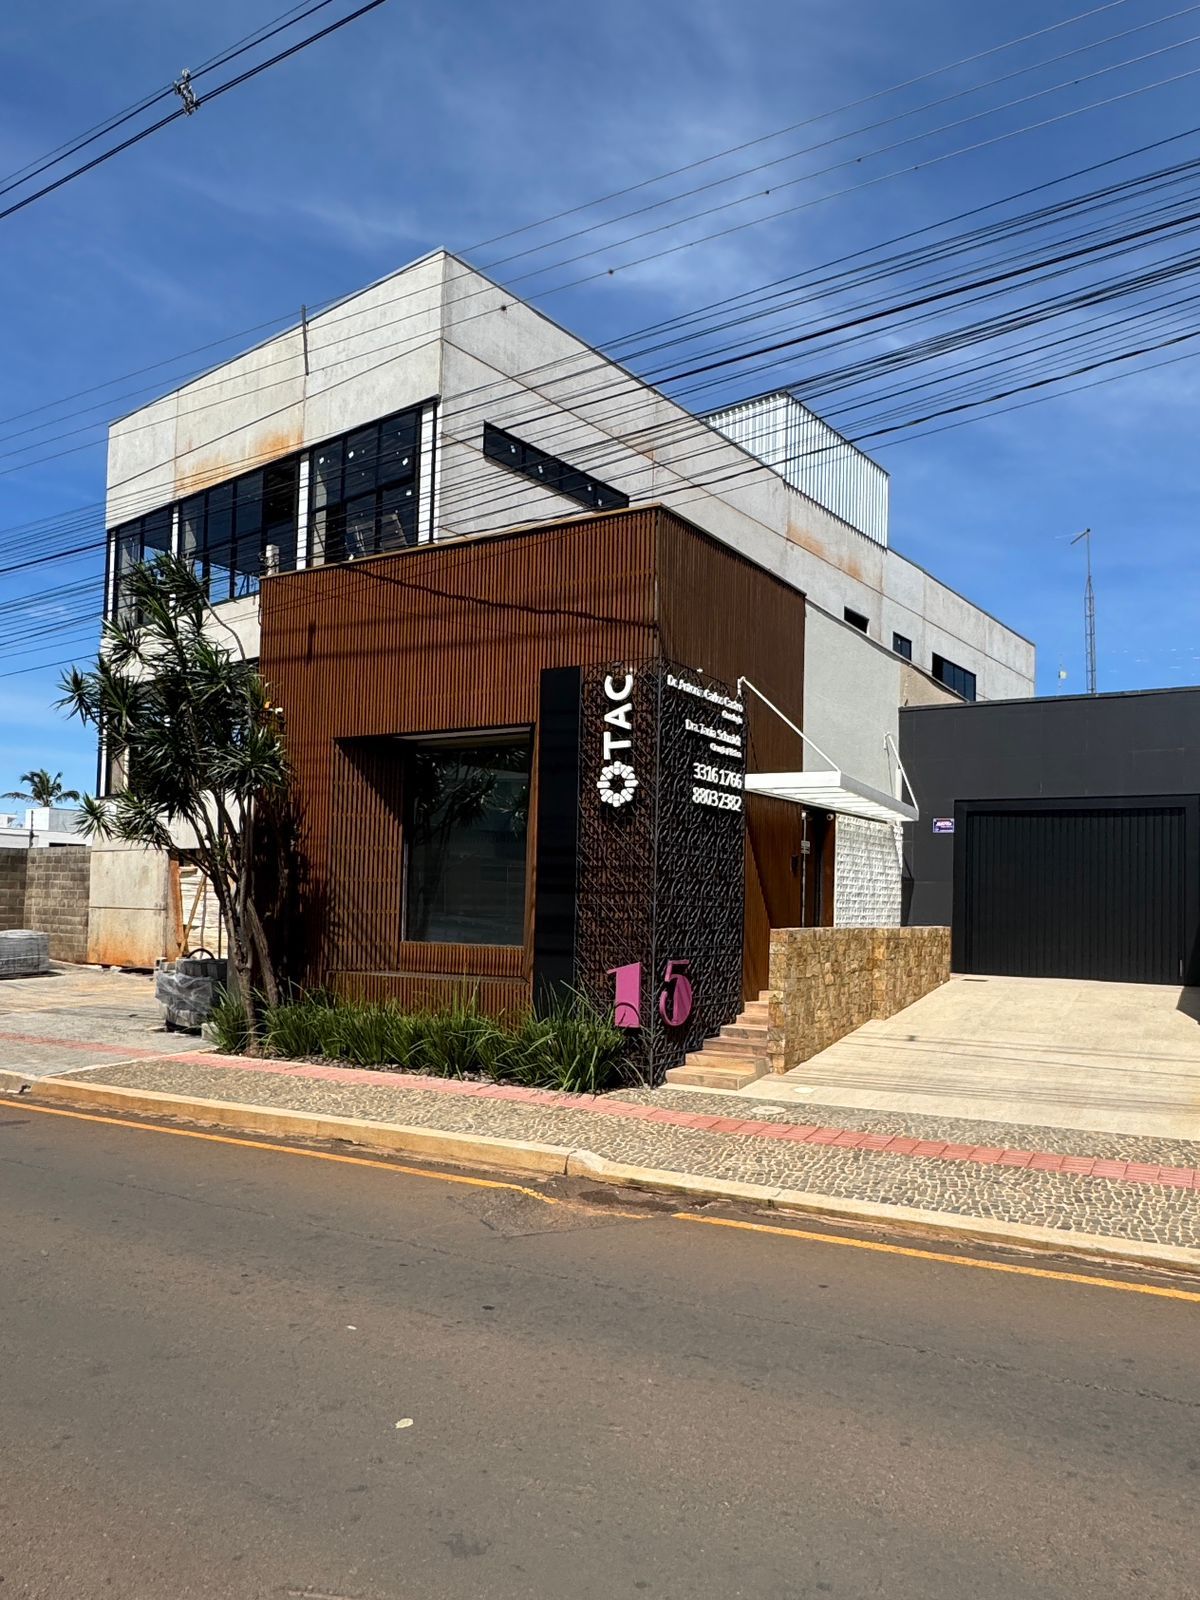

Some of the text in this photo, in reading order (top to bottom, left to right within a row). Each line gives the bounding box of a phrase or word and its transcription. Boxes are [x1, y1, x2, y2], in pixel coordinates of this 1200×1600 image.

[693, 762, 742, 789] 3316 1766
[718, 792, 742, 812] 2382
